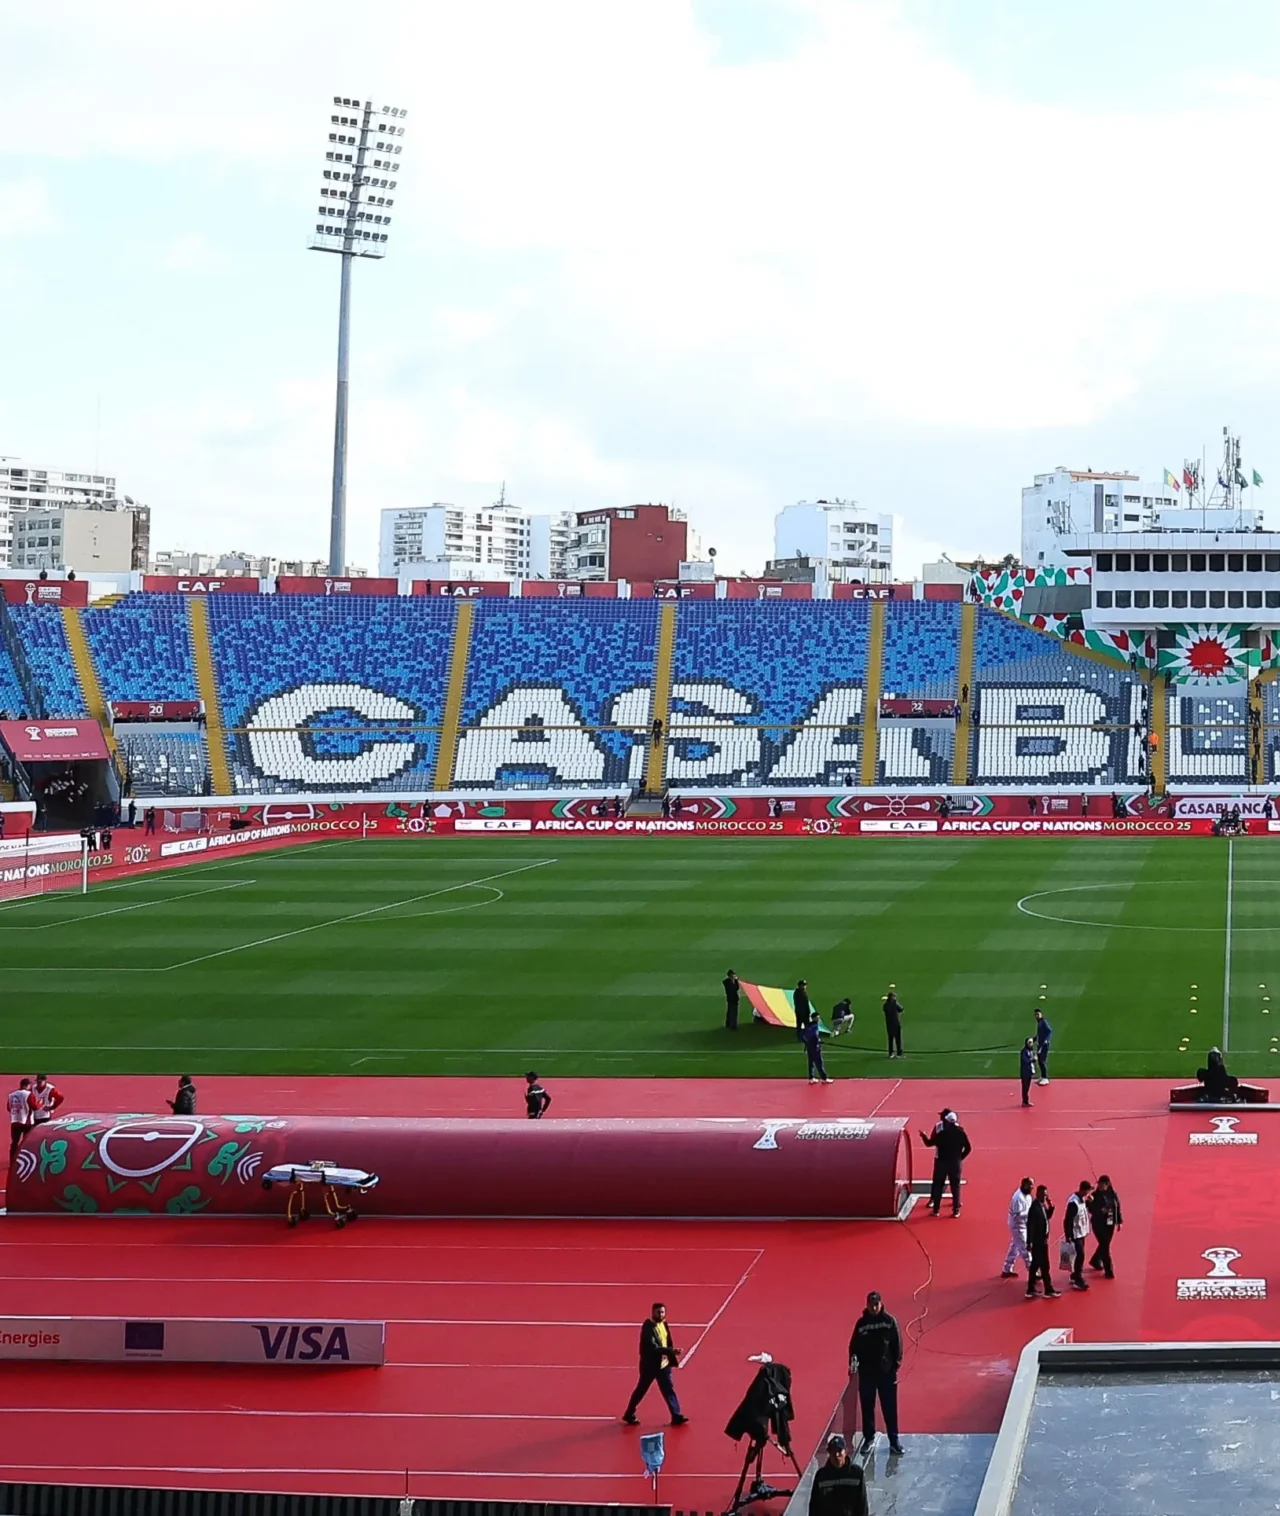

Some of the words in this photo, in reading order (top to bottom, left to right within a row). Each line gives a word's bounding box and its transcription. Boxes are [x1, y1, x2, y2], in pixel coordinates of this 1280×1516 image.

[177, 581, 221, 592] CAF
[440, 586, 480, 596] CAF
[853, 589, 890, 599] CAF
[150, 705, 163, 714] 20
[912, 703, 924, 711] 22
[484, 821, 523, 829] CAF
[535, 820, 586, 830] AFRICA
[586, 820, 613, 830] CUP
[615, 820, 633, 830] OF
[635, 820, 695, 830] NATIONS
[695, 821, 766, 830] MOROCCO
[769, 821, 783, 830] 25
[942, 821, 992, 831] AFRICA
[993, 821, 1020, 831] CUP
[1022, 821, 1041, 831] OF
[1043, 821, 1102, 831] NATIONS
[1103, 821, 1174, 831] MOROCCO
[1176, 821, 1191, 831] 25
[208, 834, 236, 848] AFRICA
[236, 832, 250, 843] CUP
[250, 830, 261, 840] OF
[261, 824, 291, 839] NATIONS
[290, 820, 360, 832] MOROCCO
[364, 819, 378, 829] 25
[179, 838, 202, 851] CAF
[3, 863, 50, 882] NATONS
[102, 853, 113, 865] 25
[0, 1330, 60, 1348] nergies
[252, 1325, 350, 1361] VISA
